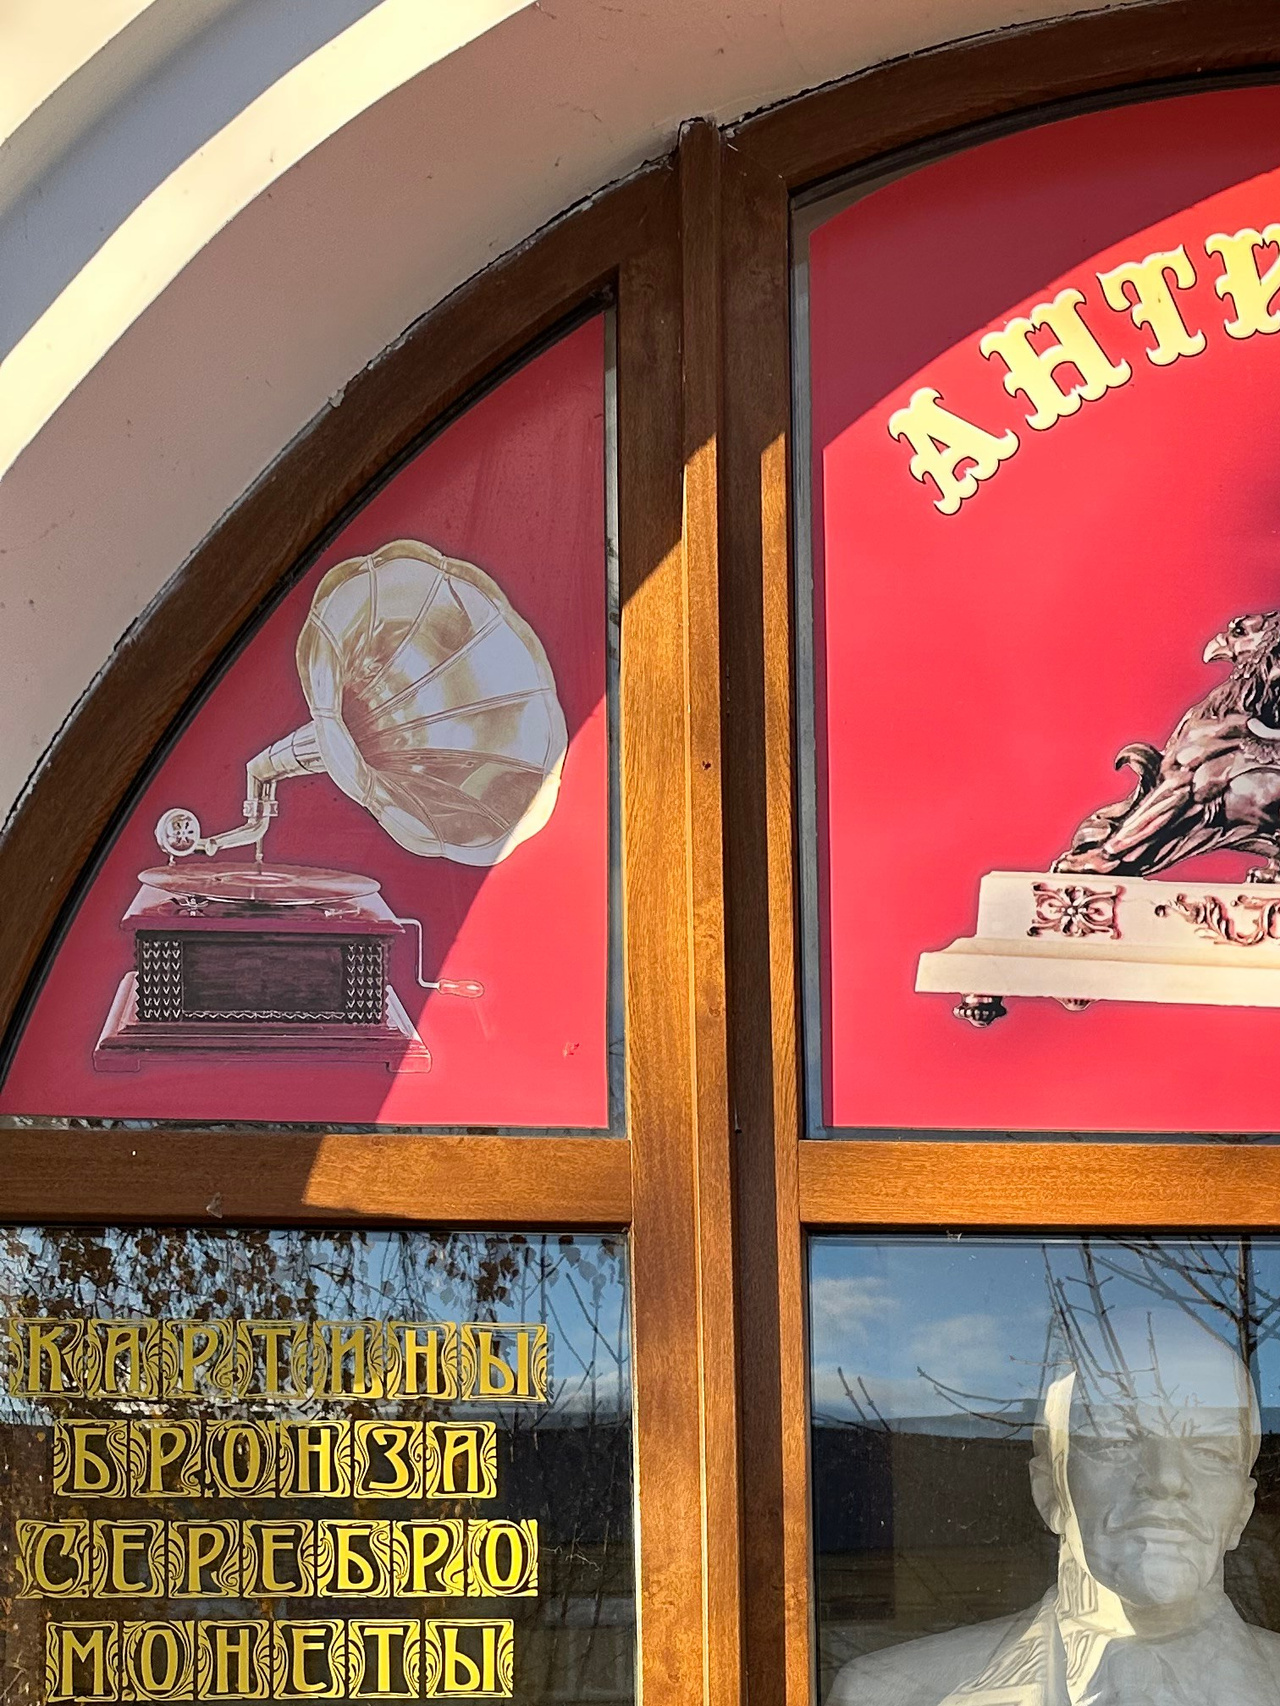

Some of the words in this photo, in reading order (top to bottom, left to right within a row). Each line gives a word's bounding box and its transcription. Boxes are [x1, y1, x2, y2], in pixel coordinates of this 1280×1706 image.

[24, 1323, 533, 1398] КАРТИНЫ
[70, 1424, 484, 1494] БРОНЗА
[33, 1524, 524, 1594] СЕРЕБРО
[59, 1624, 500, 1697] МОНЕТЫ
